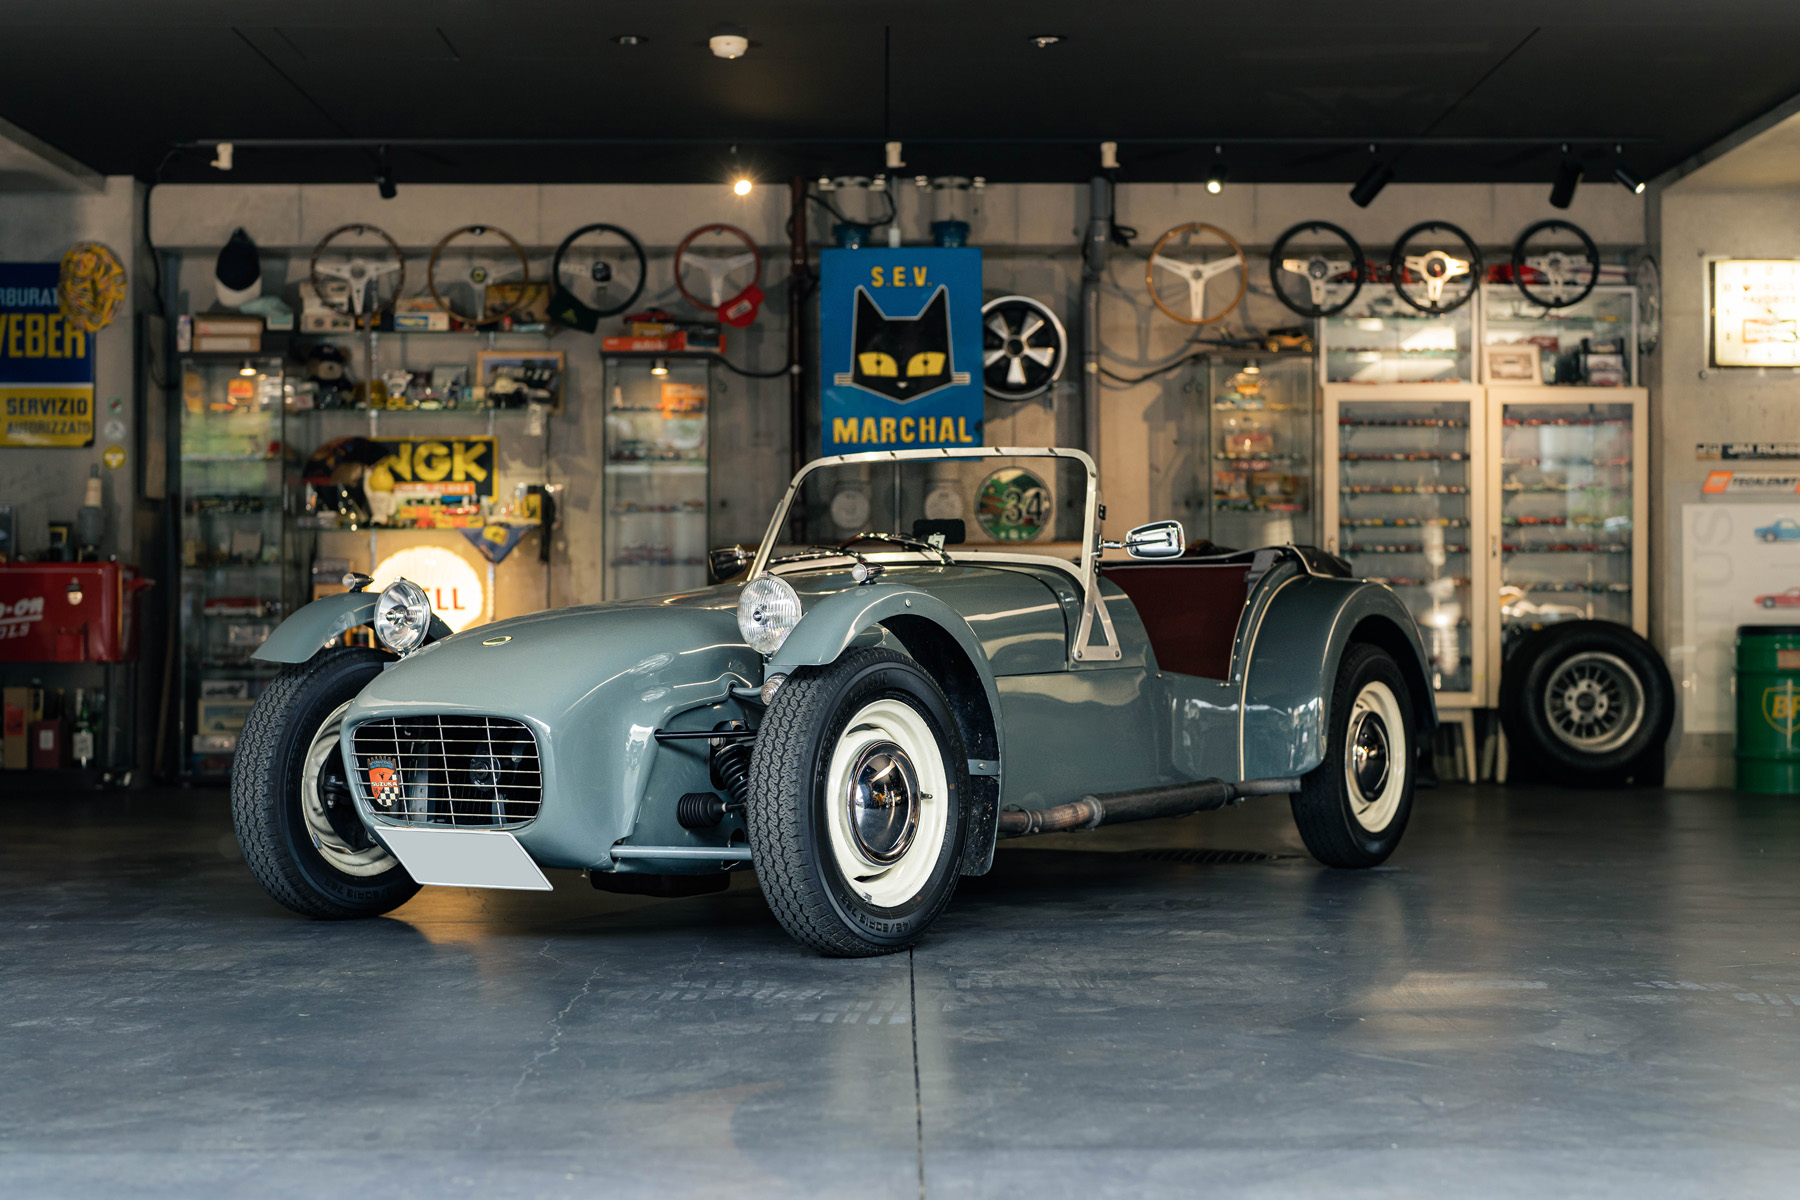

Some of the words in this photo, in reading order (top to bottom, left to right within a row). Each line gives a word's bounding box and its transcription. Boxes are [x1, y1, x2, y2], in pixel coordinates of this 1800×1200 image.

[871, 266, 932, 287] S.E.V.
[7, 398, 88, 416] SERVIZIO
[7, 420, 91, 435] AUTORIZZATO
[832, 416, 973, 444] MARCHAL
[1004, 489, 1043, 522] 34
